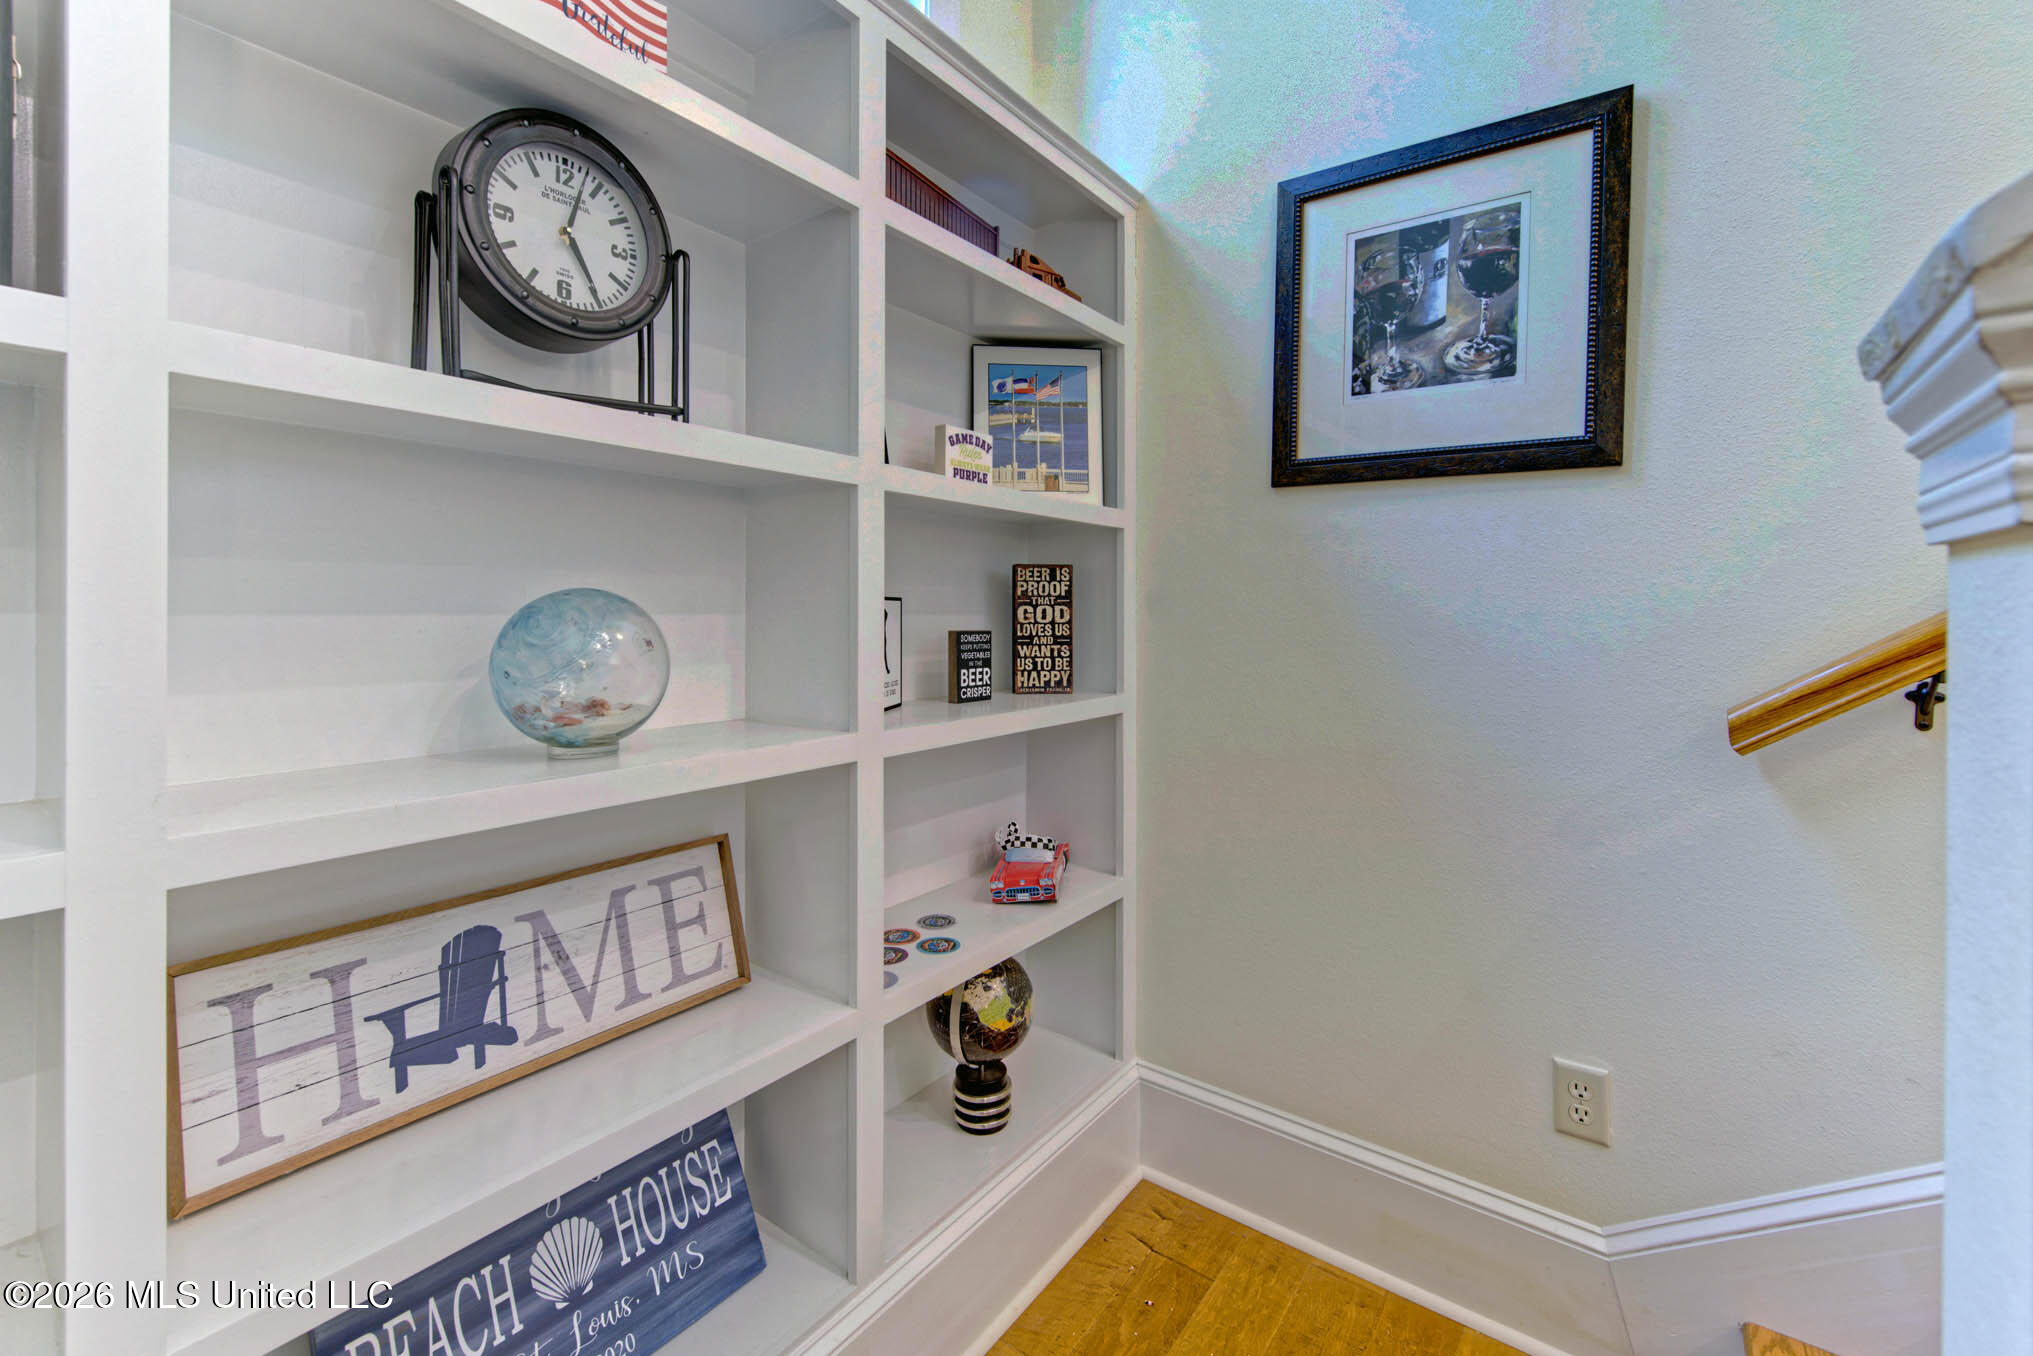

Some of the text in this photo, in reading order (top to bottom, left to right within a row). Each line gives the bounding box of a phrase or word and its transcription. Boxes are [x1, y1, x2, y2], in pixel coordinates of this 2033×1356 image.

[555, 164, 575, 189] 12
[492, 202, 514, 223] 9
[611, 244, 628, 261] 3
[556, 279, 572, 300] 6
[948, 433, 992, 454] GAME DAY
[953, 467, 988, 484] PURPLE
[1017, 567, 1070, 581] BEER IS
[1017, 581, 1070, 597] PROOF
[1031, 596, 1056, 605] THAT
[1017, 605, 1070, 624] GOD
[960, 634, 991, 642] SOMEBODY
[1017, 623, 1070, 637] LOVES US
[1032, 636, 1054, 645] AND
[960, 651, 991, 660] VEGETABLES
[1018, 645, 1070, 657] WANTS
[1017, 658, 1070, 671] US TO BE
[960, 667, 991, 687] BEER
[1017, 671, 1070, 687] HAPPY
[960, 686, 991, 699] CRISPER
[607, 1138, 732, 1267] HOUSE
[647, 1240, 704, 1296] MS
